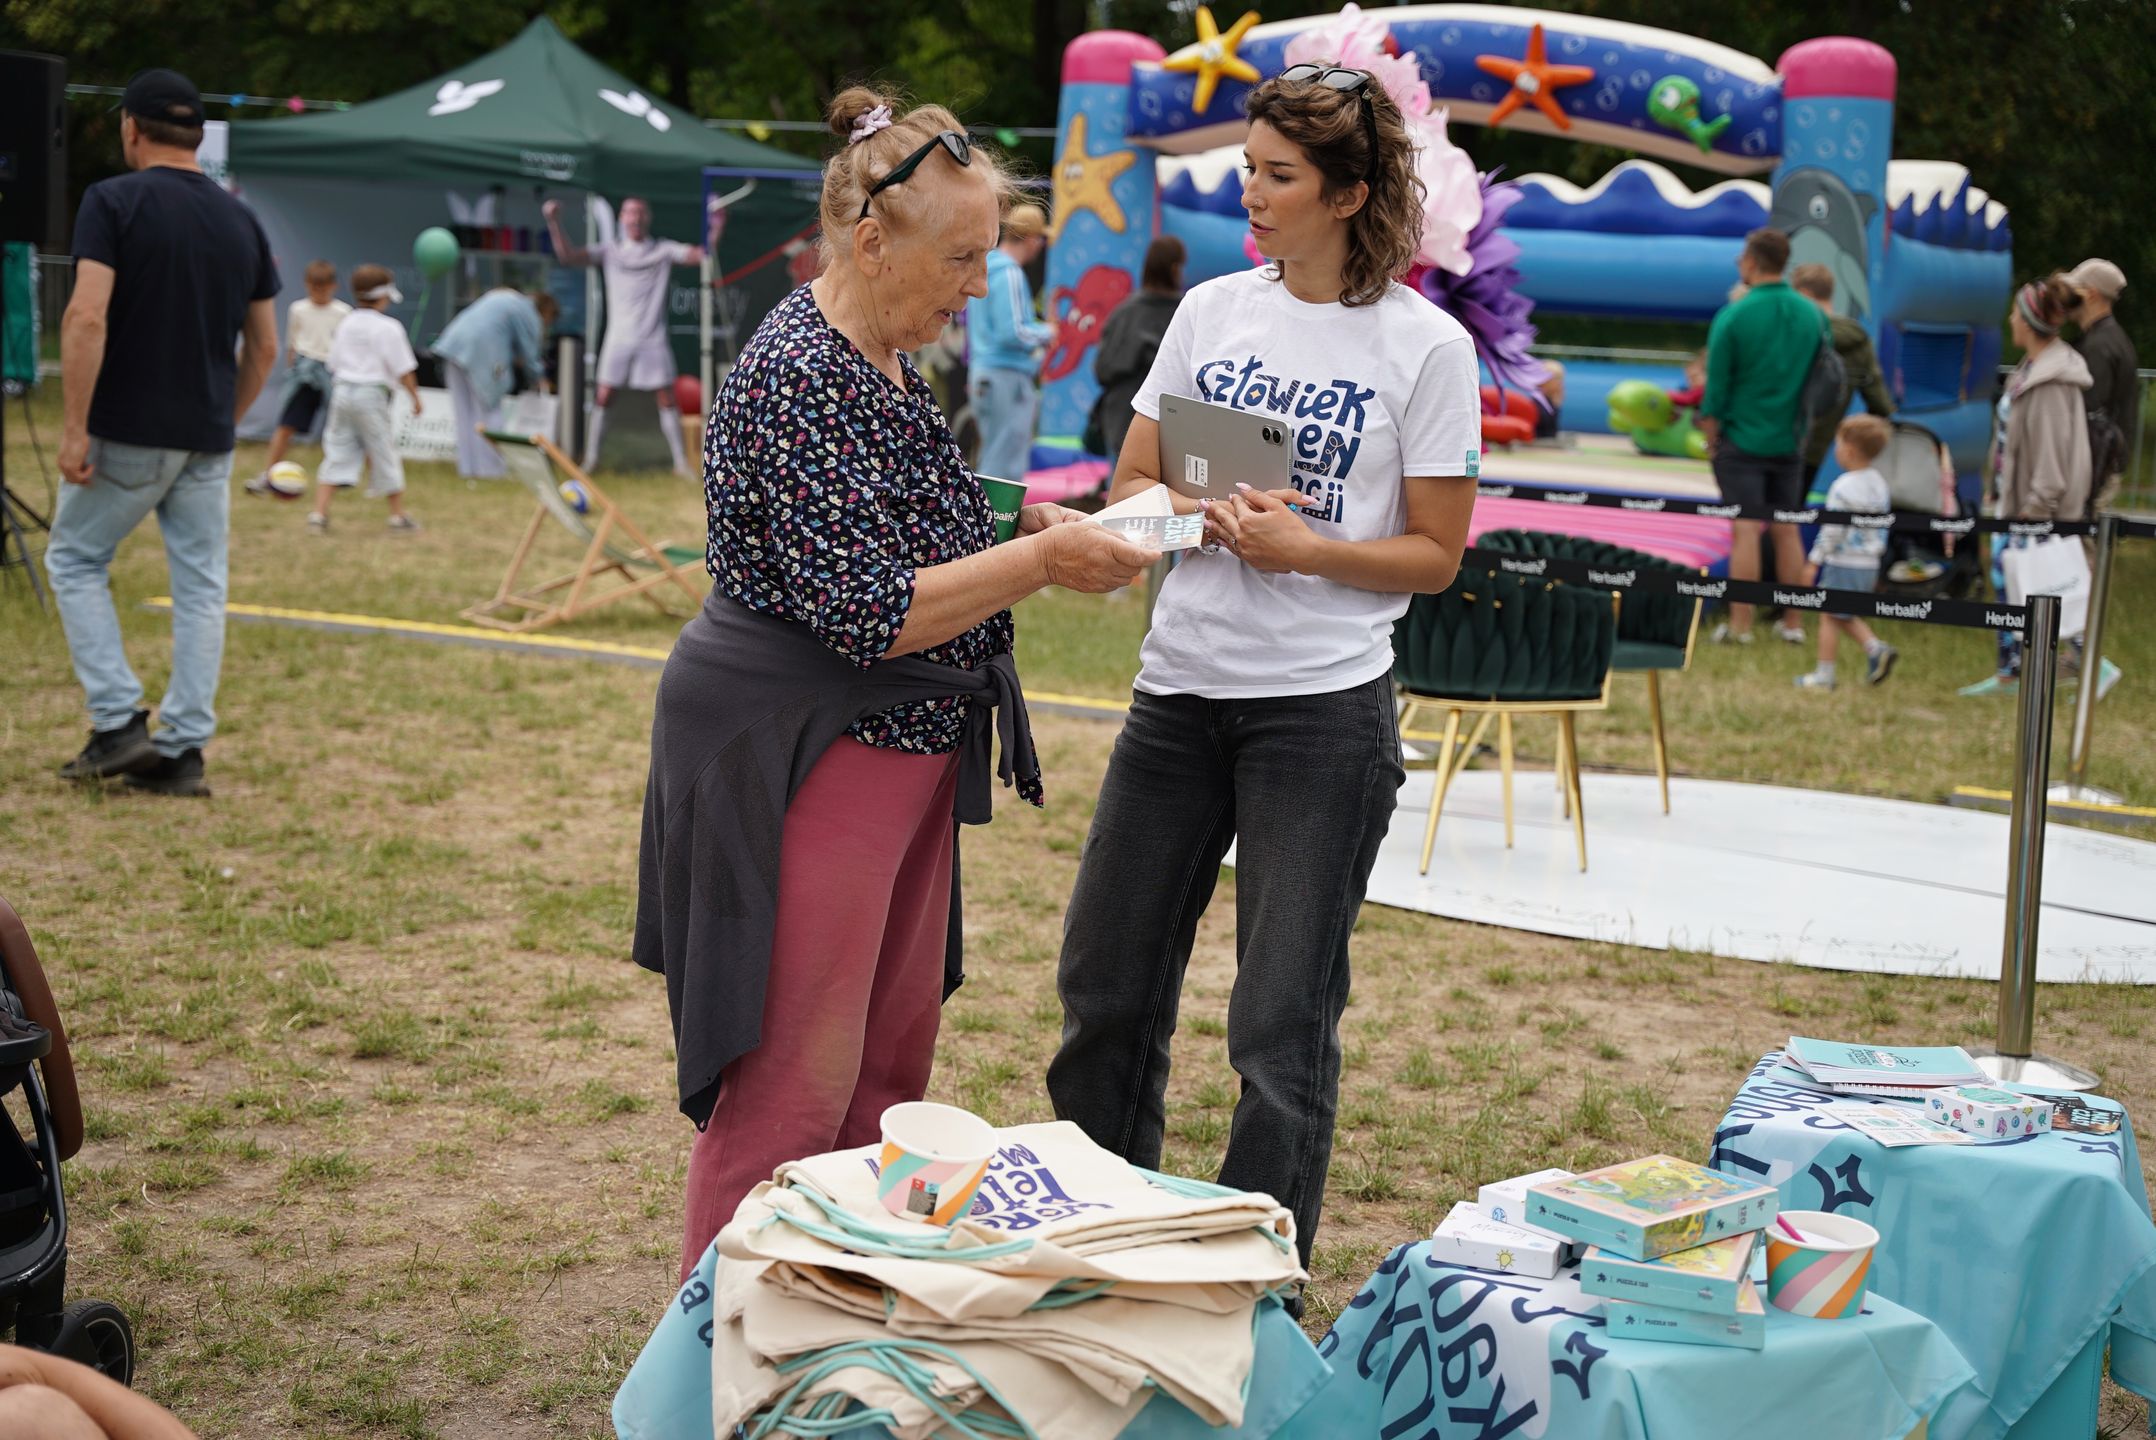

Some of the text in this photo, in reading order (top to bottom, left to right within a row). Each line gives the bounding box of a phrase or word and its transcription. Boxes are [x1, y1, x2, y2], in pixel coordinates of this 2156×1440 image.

[1501, 558, 1544, 574] Herbalife
[1588, 570, 1633, 587] Herbalife
[1677, 581, 1724, 598] Herbalife
[1774, 591, 1823, 608] Herbalife
[1876, 601, 1928, 619] Herbalife
